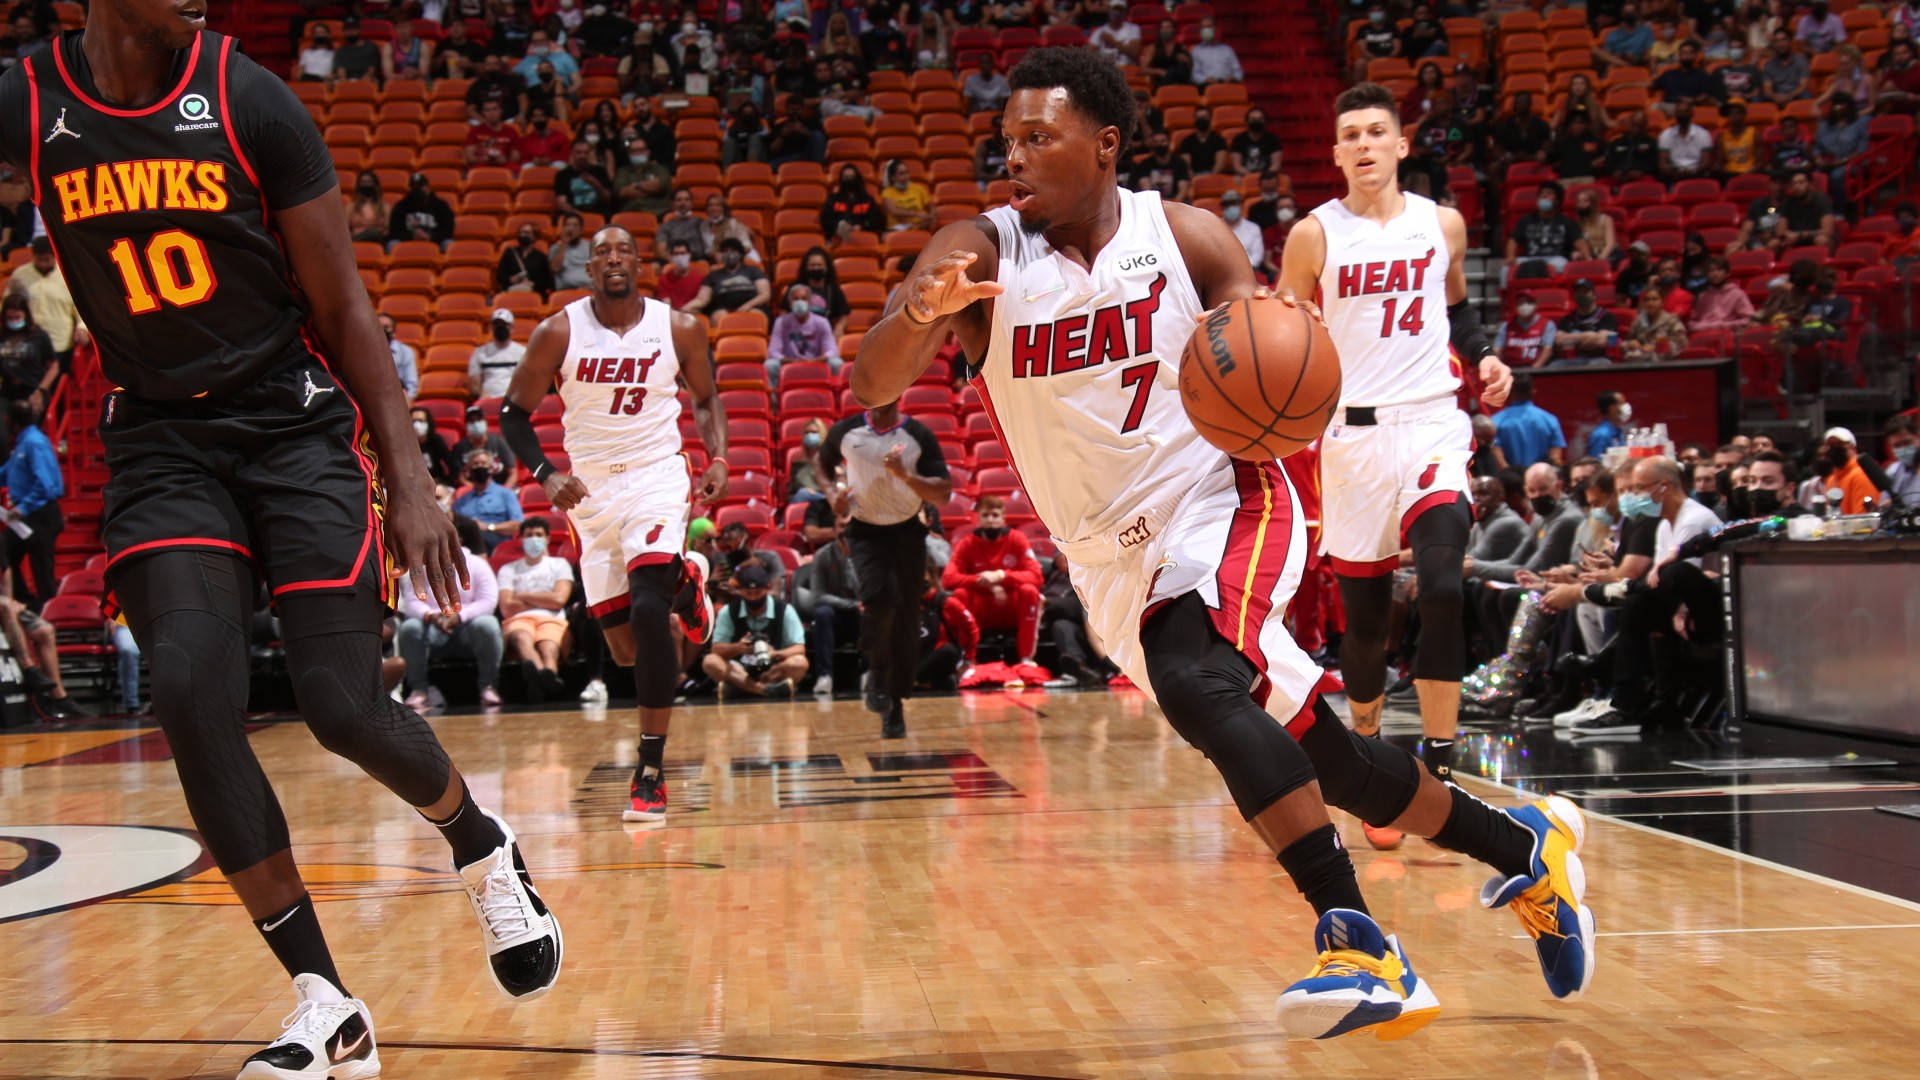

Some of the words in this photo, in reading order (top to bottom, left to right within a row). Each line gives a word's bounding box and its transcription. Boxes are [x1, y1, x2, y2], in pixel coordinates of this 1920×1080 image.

[175, 120, 219, 132] sharecare
[52, 159, 229, 225] HAWKS
[107, 228, 219, 316] 10
[1338, 245, 1436, 299] HEAT
[1012, 271, 1168, 379] HEAT
[1380, 296, 1424, 338] 14
[576, 347, 662, 384] HEAT
[609, 386, 648, 416] 13
[1120, 360, 1161, 435] 7
